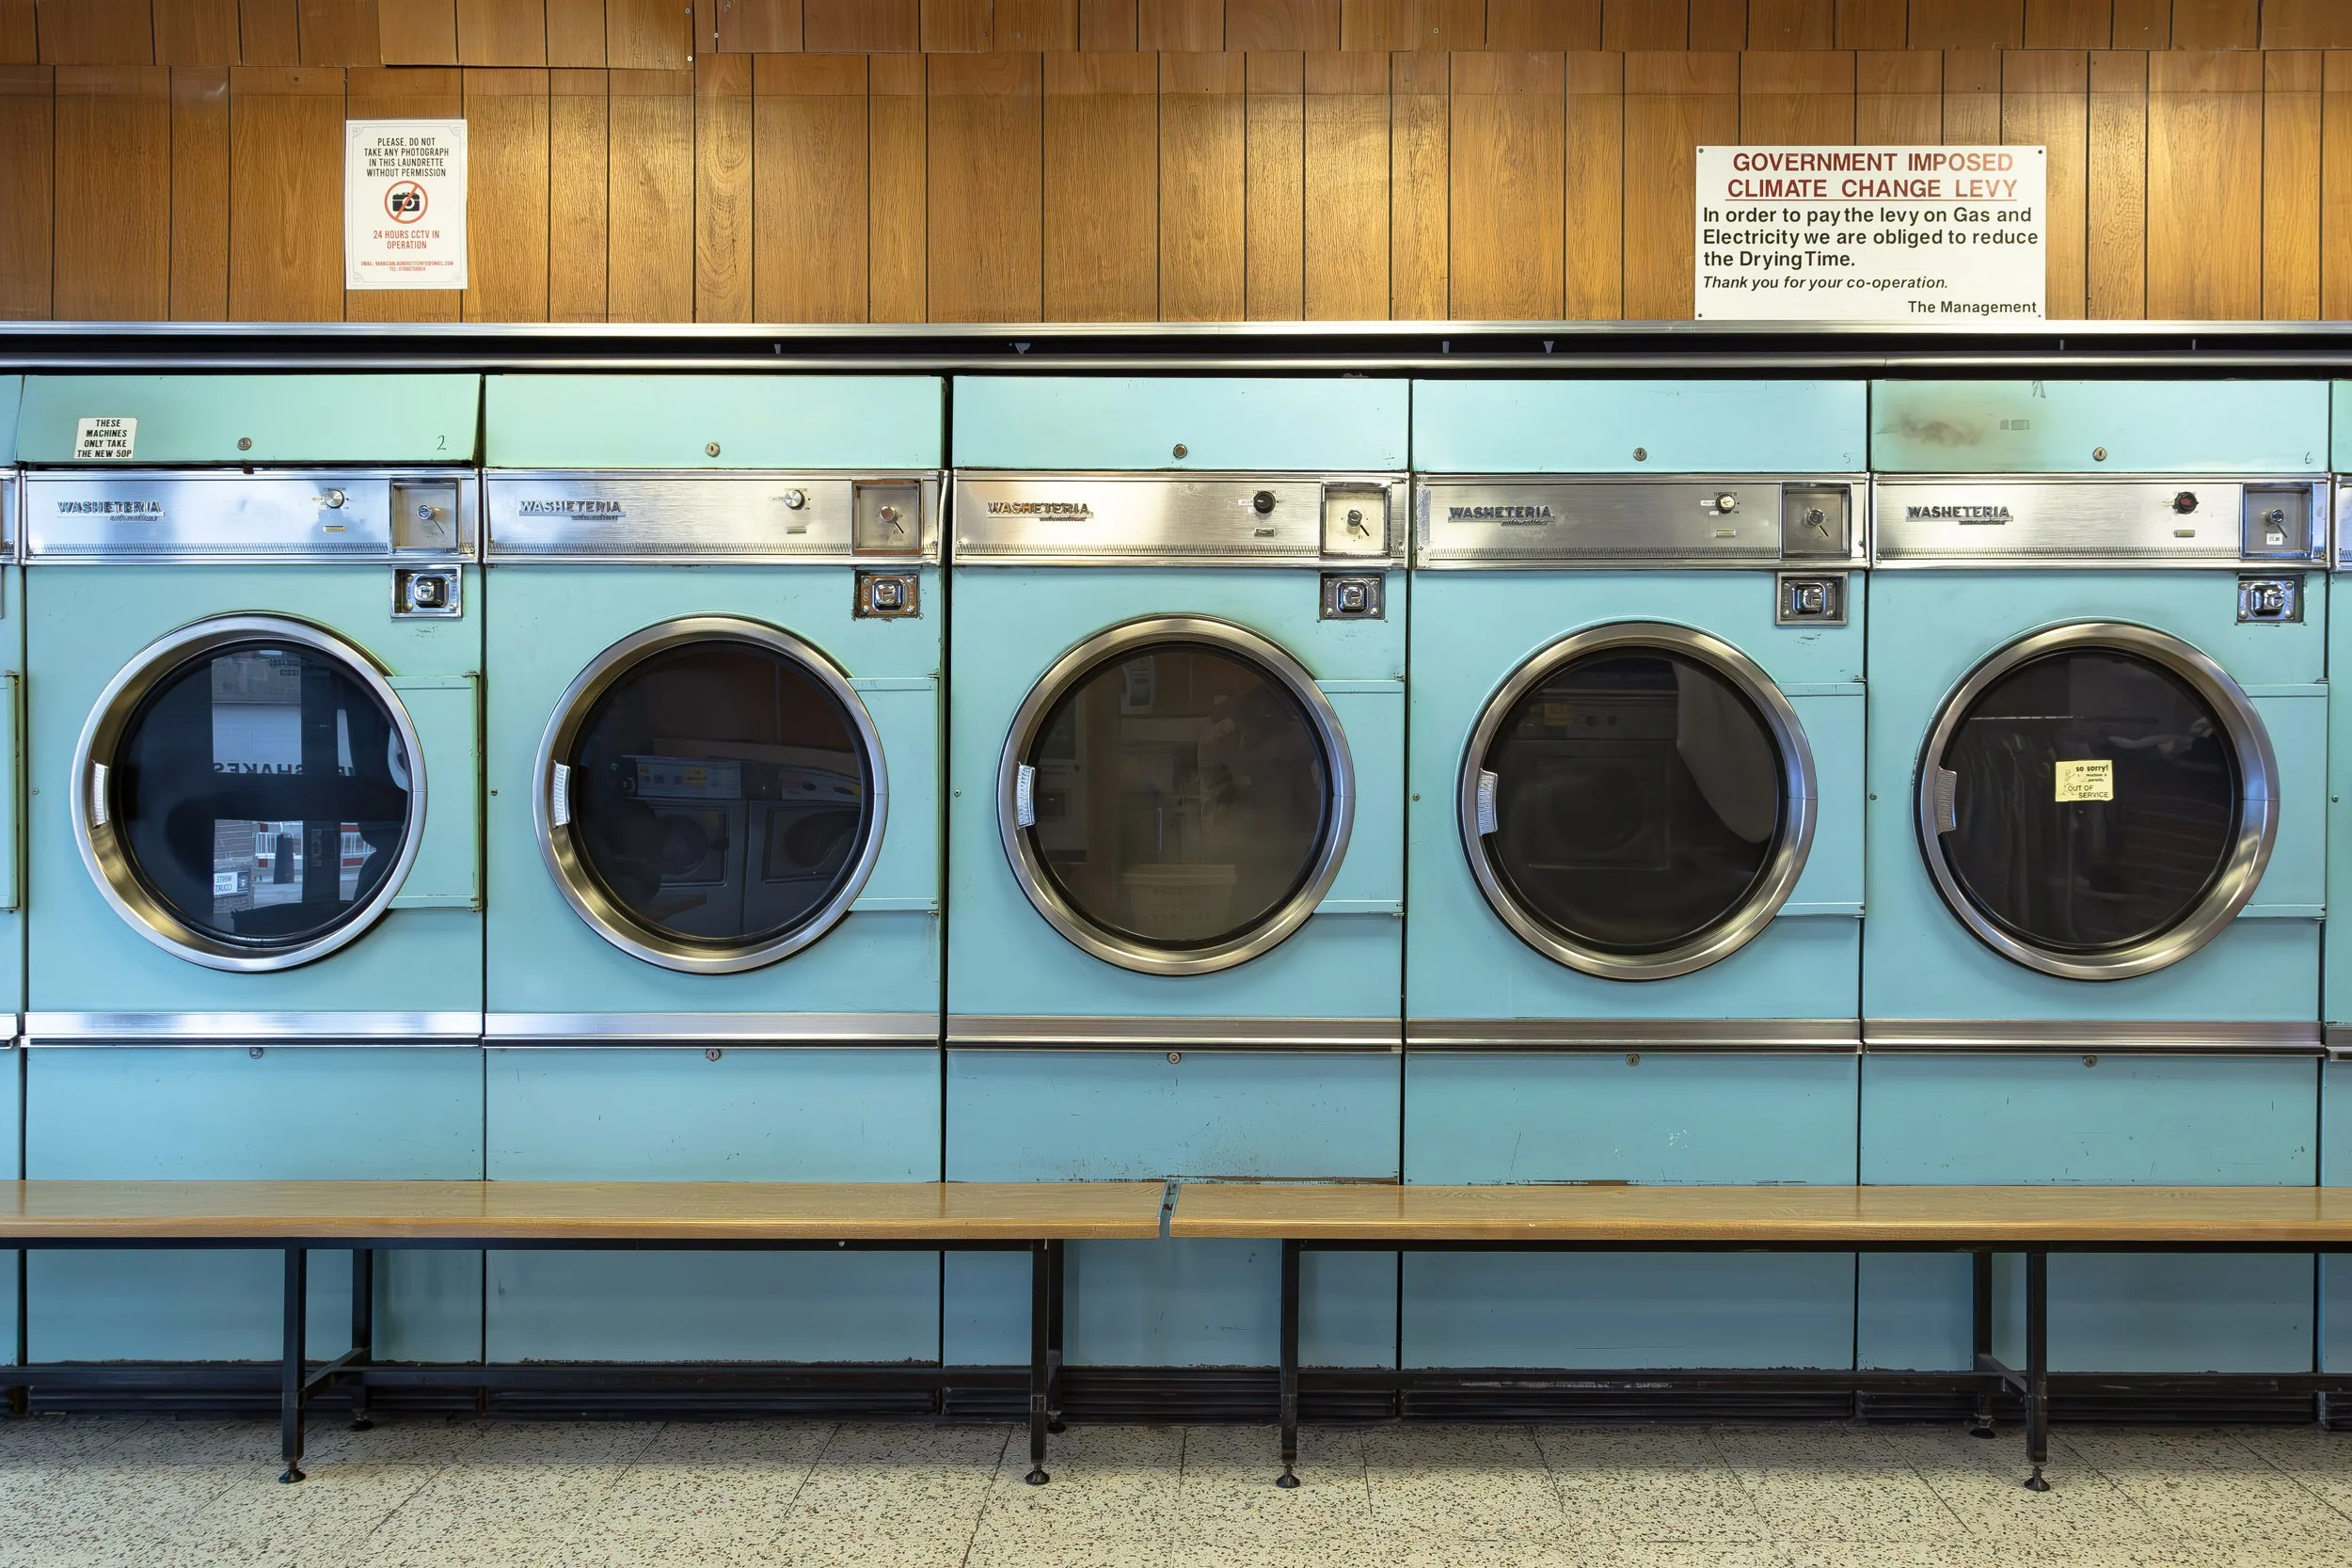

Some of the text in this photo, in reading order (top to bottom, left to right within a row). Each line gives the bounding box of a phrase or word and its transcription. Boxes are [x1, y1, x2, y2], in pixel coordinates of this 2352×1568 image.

[409, 137, 420, 147] DO
[421, 137, 436, 147] NOT
[364, 148, 449, 157] TAKE ANY PHOTOGRAPH
[369, 158, 444, 167] IN THIS LAUNDRETTE
[1733, 152, 2014, 171] GOVERNMENT IMPOSED
[366, 168, 447, 178] WITHOUT PERMISSION
[1727, 179, 2018, 198] CLIMATE CHANGE LEVY
[1703, 207, 2032, 227] In order to pay the levy on Gas and
[373, 230, 440, 240] 24 HOURS CCTV IN
[1703, 230, 2039, 249] Electricity we are obliged to reduce
[387, 240, 427, 250] OPERATION
[1703, 251, 1856, 271] the Drying Time.
[1703, 276, 1948, 292] Thank you for your co-operation.
[1908, 300, 2037, 316] The Management
[96, 419, 121, 428] THESE
[86, 429, 128, 438] MACHINES
[84, 439, 127, 448] ONLY TAKE
[437, 435, 447, 451] 2
[77, 450, 132, 458] THE NEW 50P
[57, 500, 162, 514] WASHETERIA
[519, 500, 622, 514] WASHETERIA
[987, 501, 1090, 515] WASHETERIA
[1449, 506, 1552, 518] WASHETERIA
[1906, 505, 2010, 518] WASHETERIA
